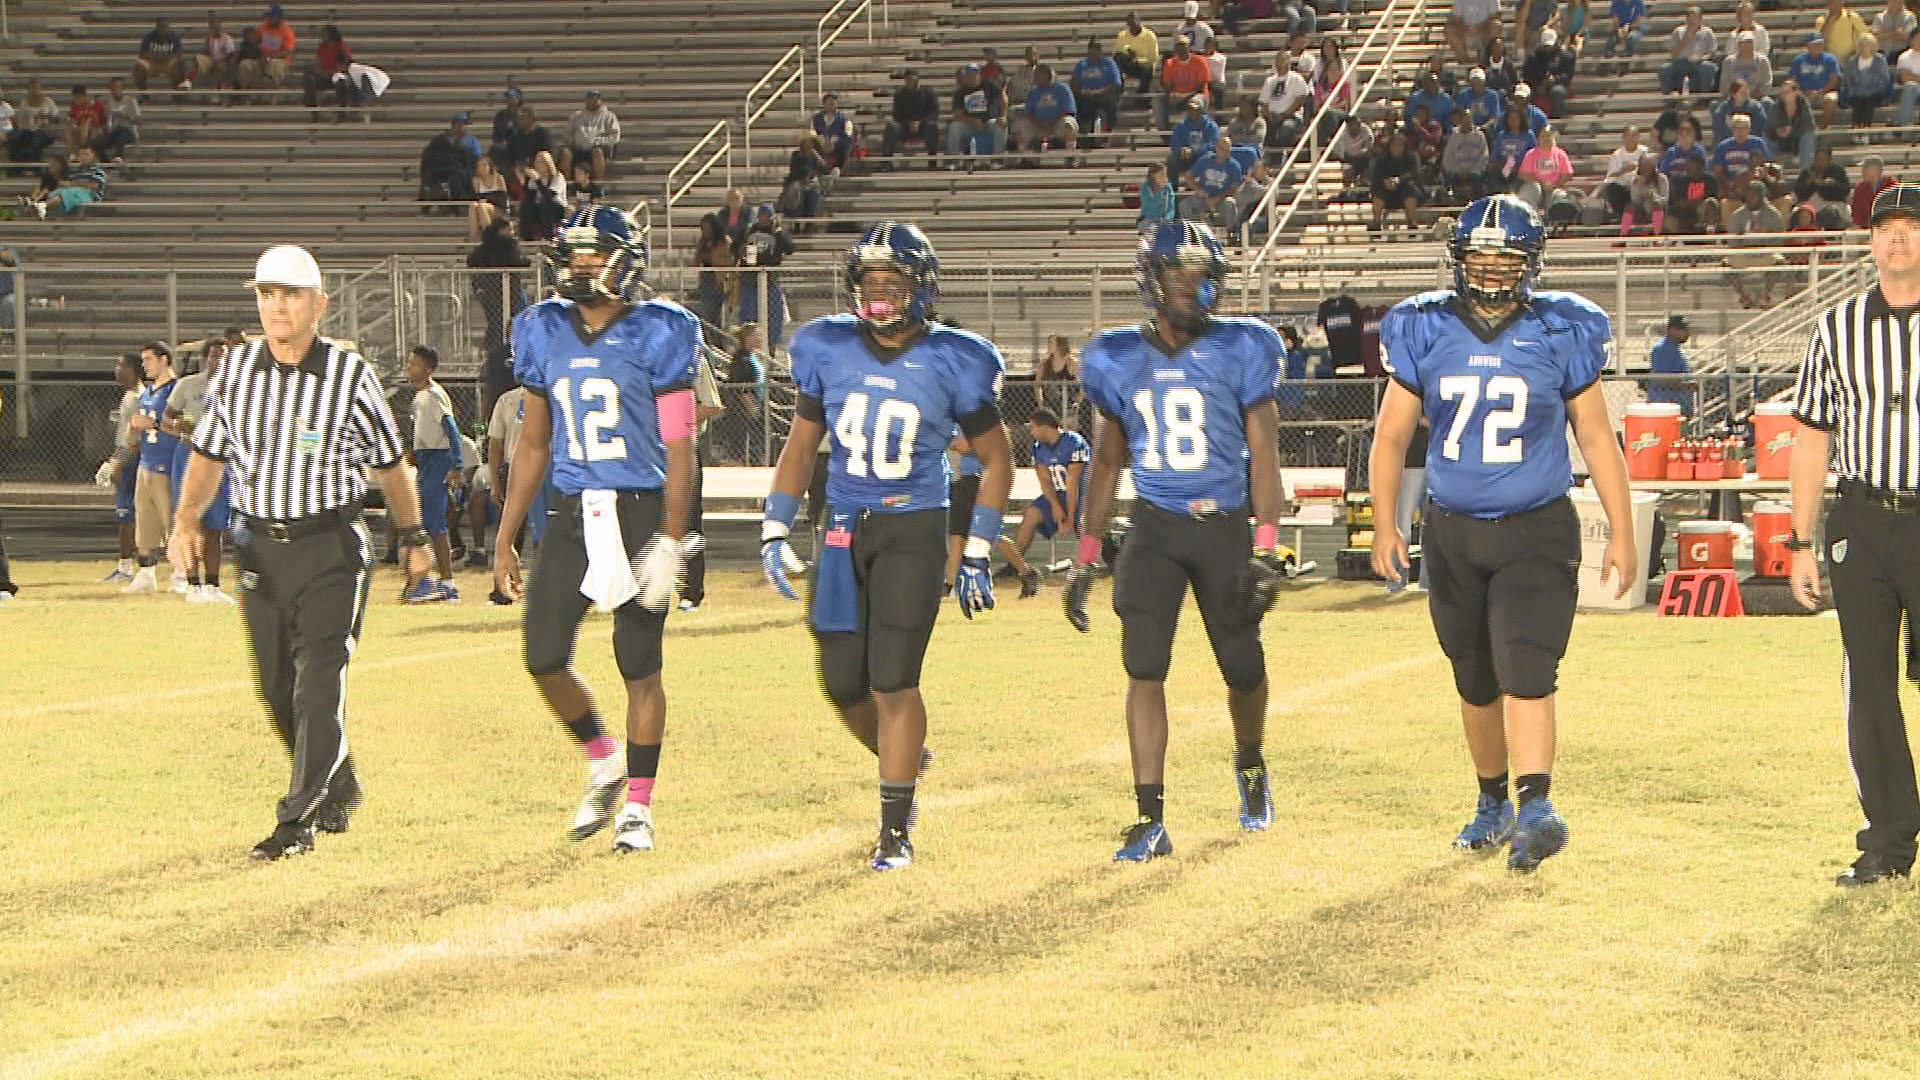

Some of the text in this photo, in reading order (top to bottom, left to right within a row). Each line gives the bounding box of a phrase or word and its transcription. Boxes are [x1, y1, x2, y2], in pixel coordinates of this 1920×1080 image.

[551, 376, 628, 461] 12
[834, 391, 922, 479] 40
[1131, 386, 1209, 471] 18
[1439, 375, 1529, 464] 72
[1690, 541, 1709, 562] G
[1663, 574, 1726, 618] 50
